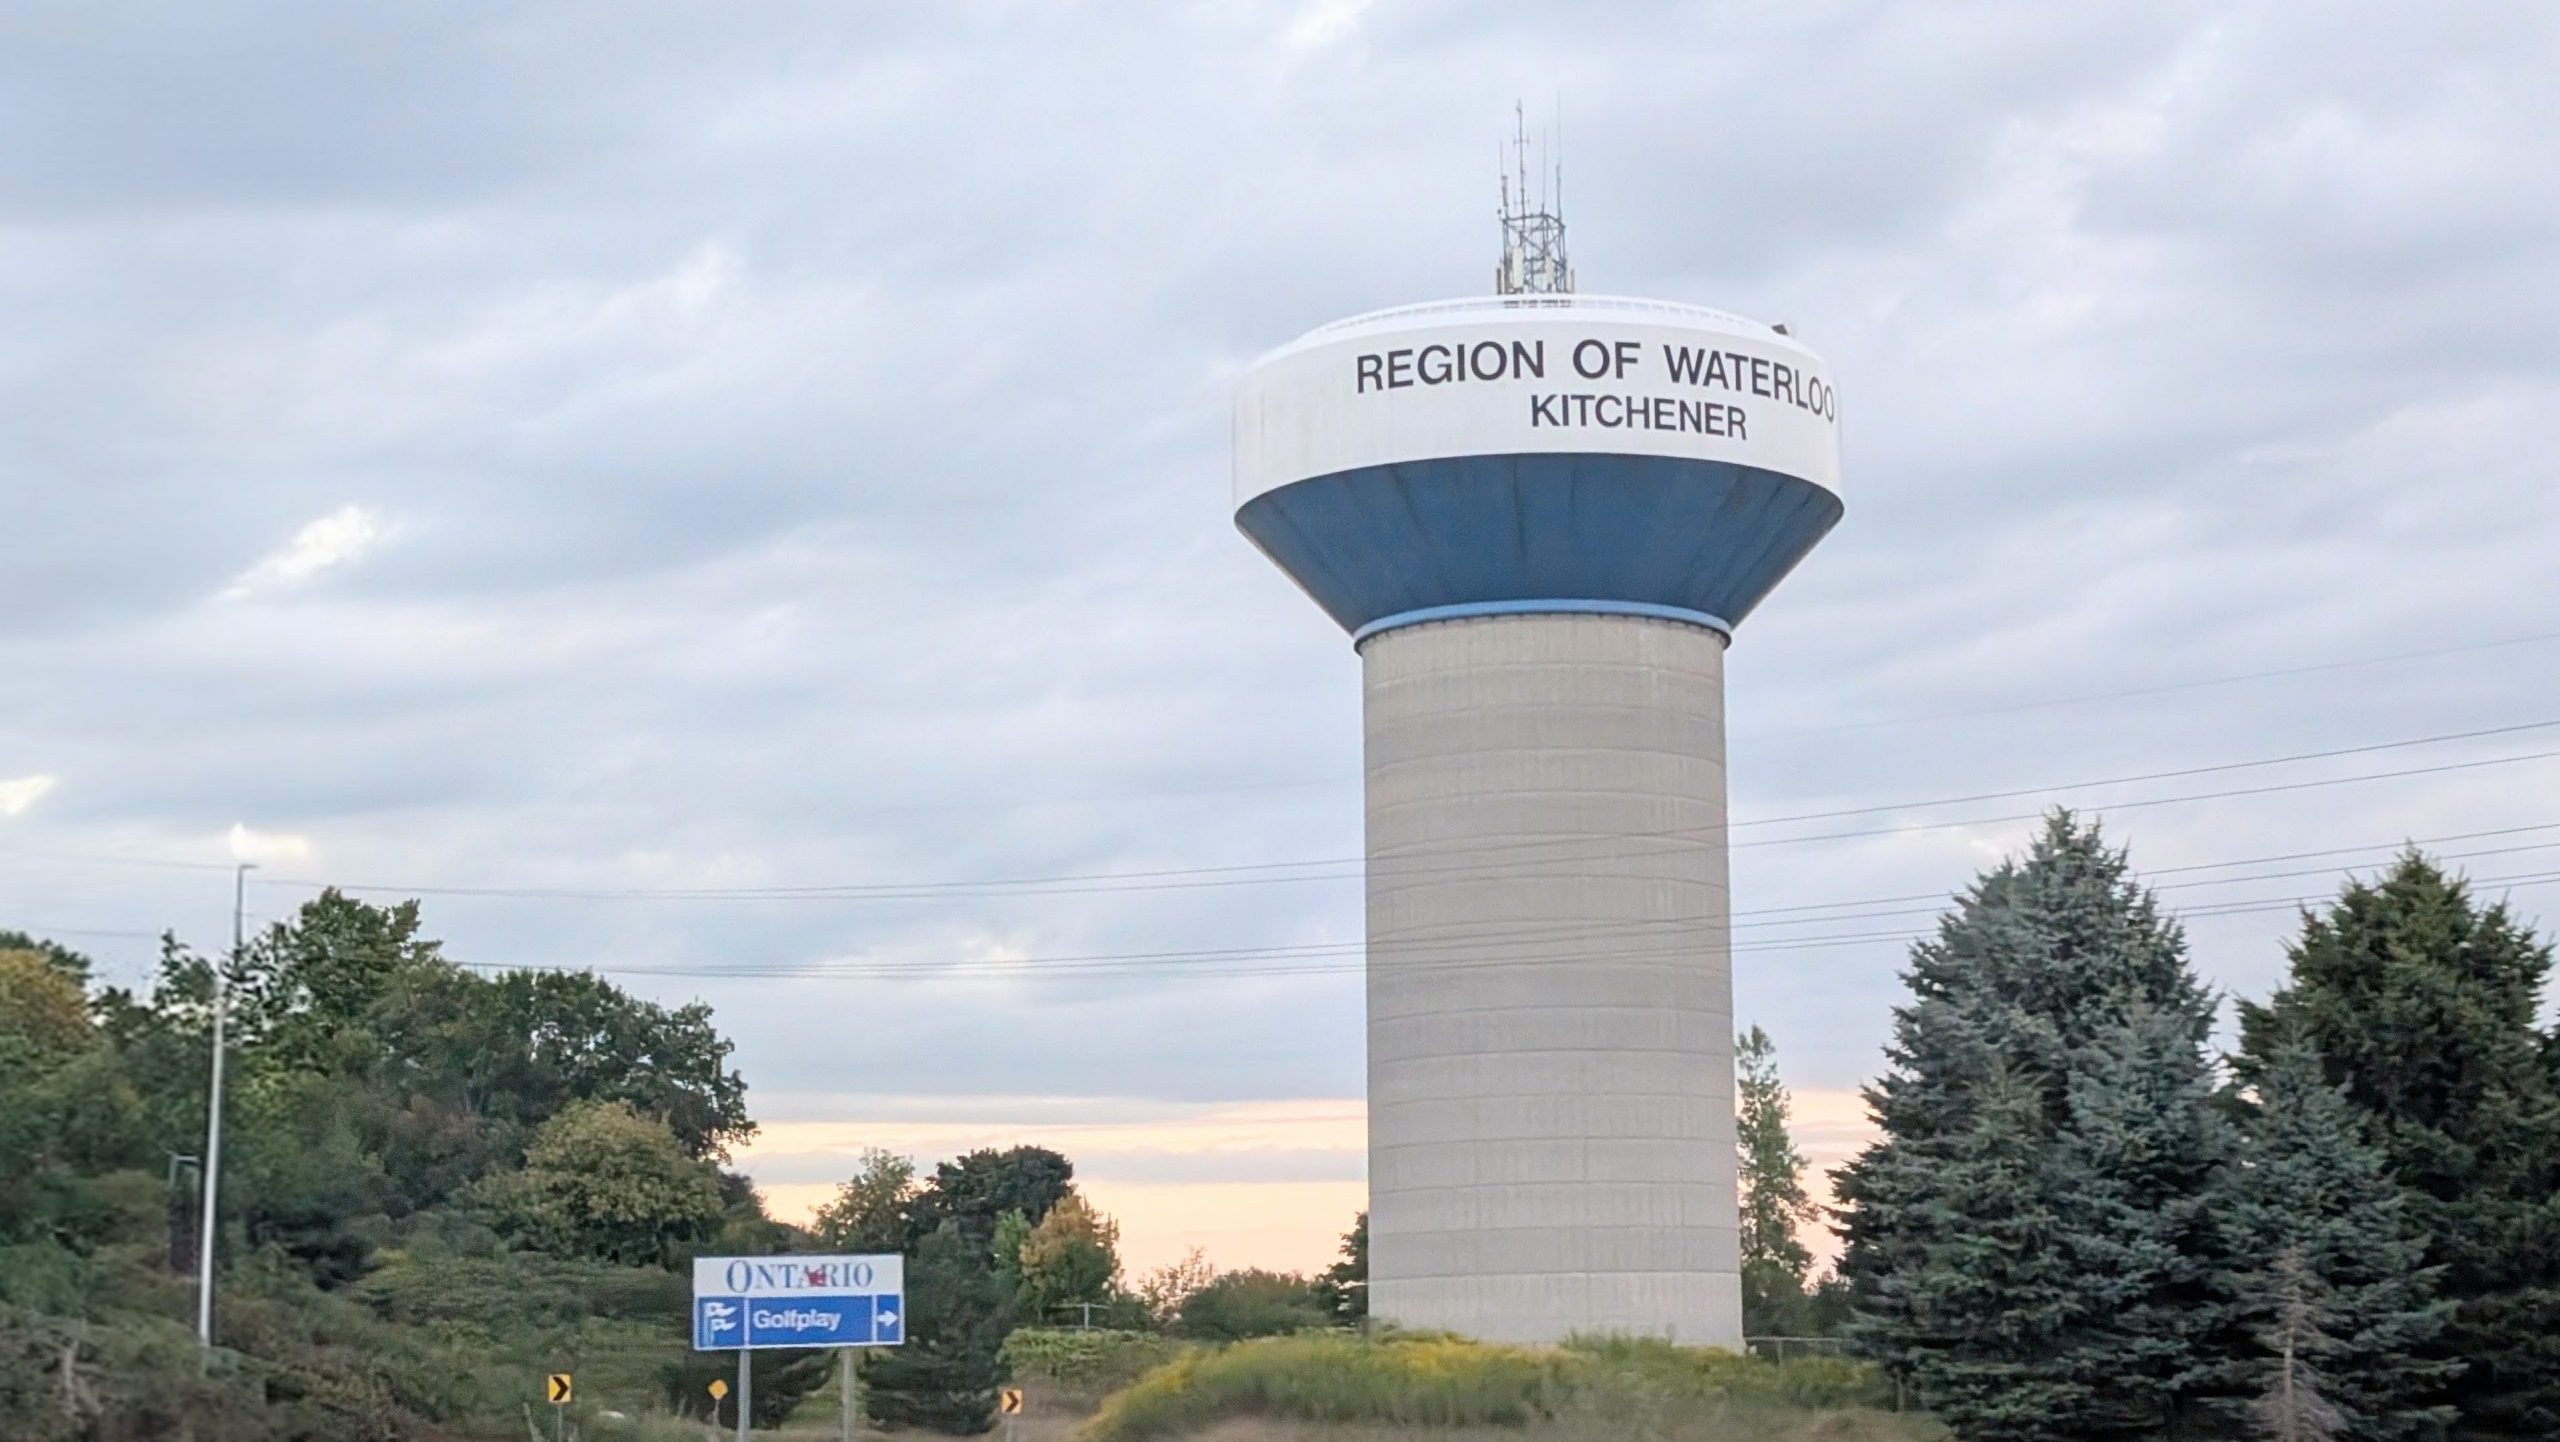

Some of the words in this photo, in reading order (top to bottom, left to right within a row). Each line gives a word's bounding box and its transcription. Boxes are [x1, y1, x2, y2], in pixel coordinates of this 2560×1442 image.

[1356, 340, 1545, 394] REGION
[1572, 338, 1641, 379] OF
[1663, 344, 1835, 424] WATERLOO
[1531, 394, 1747, 440] KITCHENER
[752, 1308, 842, 1332] Golfplay
